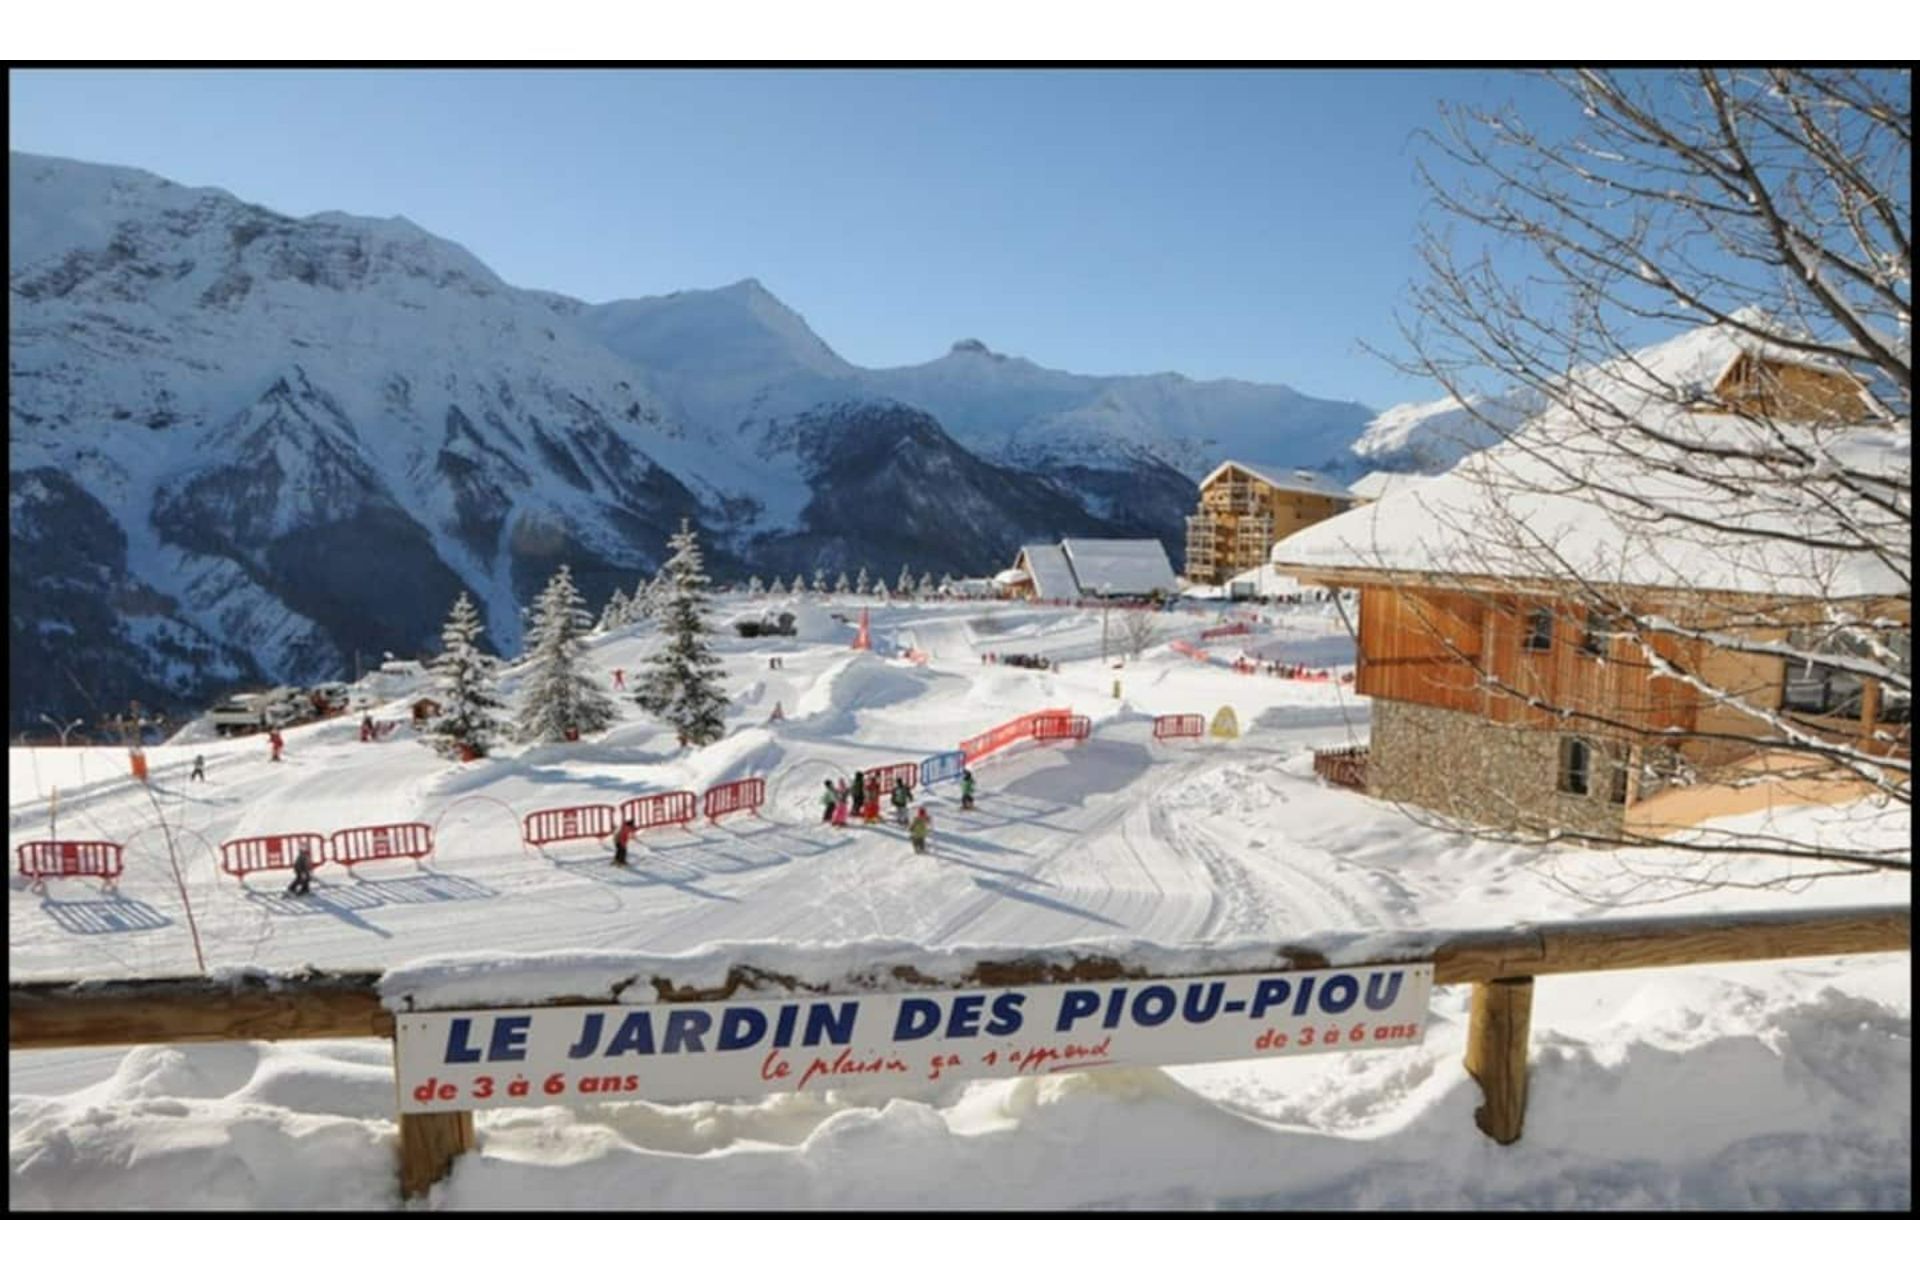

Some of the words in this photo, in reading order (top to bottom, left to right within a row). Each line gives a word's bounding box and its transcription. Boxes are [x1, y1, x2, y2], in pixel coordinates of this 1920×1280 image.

[444, 1016, 532, 1064] LE
[568, 1002, 860, 1059] JARDIN
[893, 992, 1026, 1042] DES
[1054, 970, 1403, 1032] PIOU-PIOU
[1254, 1029, 1288, 1051] de
[1296, 1026, 1316, 1047] 3
[1322, 1023, 1340, 1044] à
[1348, 1022, 1366, 1043] 6
[1373, 1022, 1418, 1041] ans
[413, 1079, 458, 1103] de
[471, 1076, 495, 1098] 3
[506, 1072, 530, 1096] à
[542, 1072, 566, 1095] 6
[577, 1073, 639, 1093] ans
